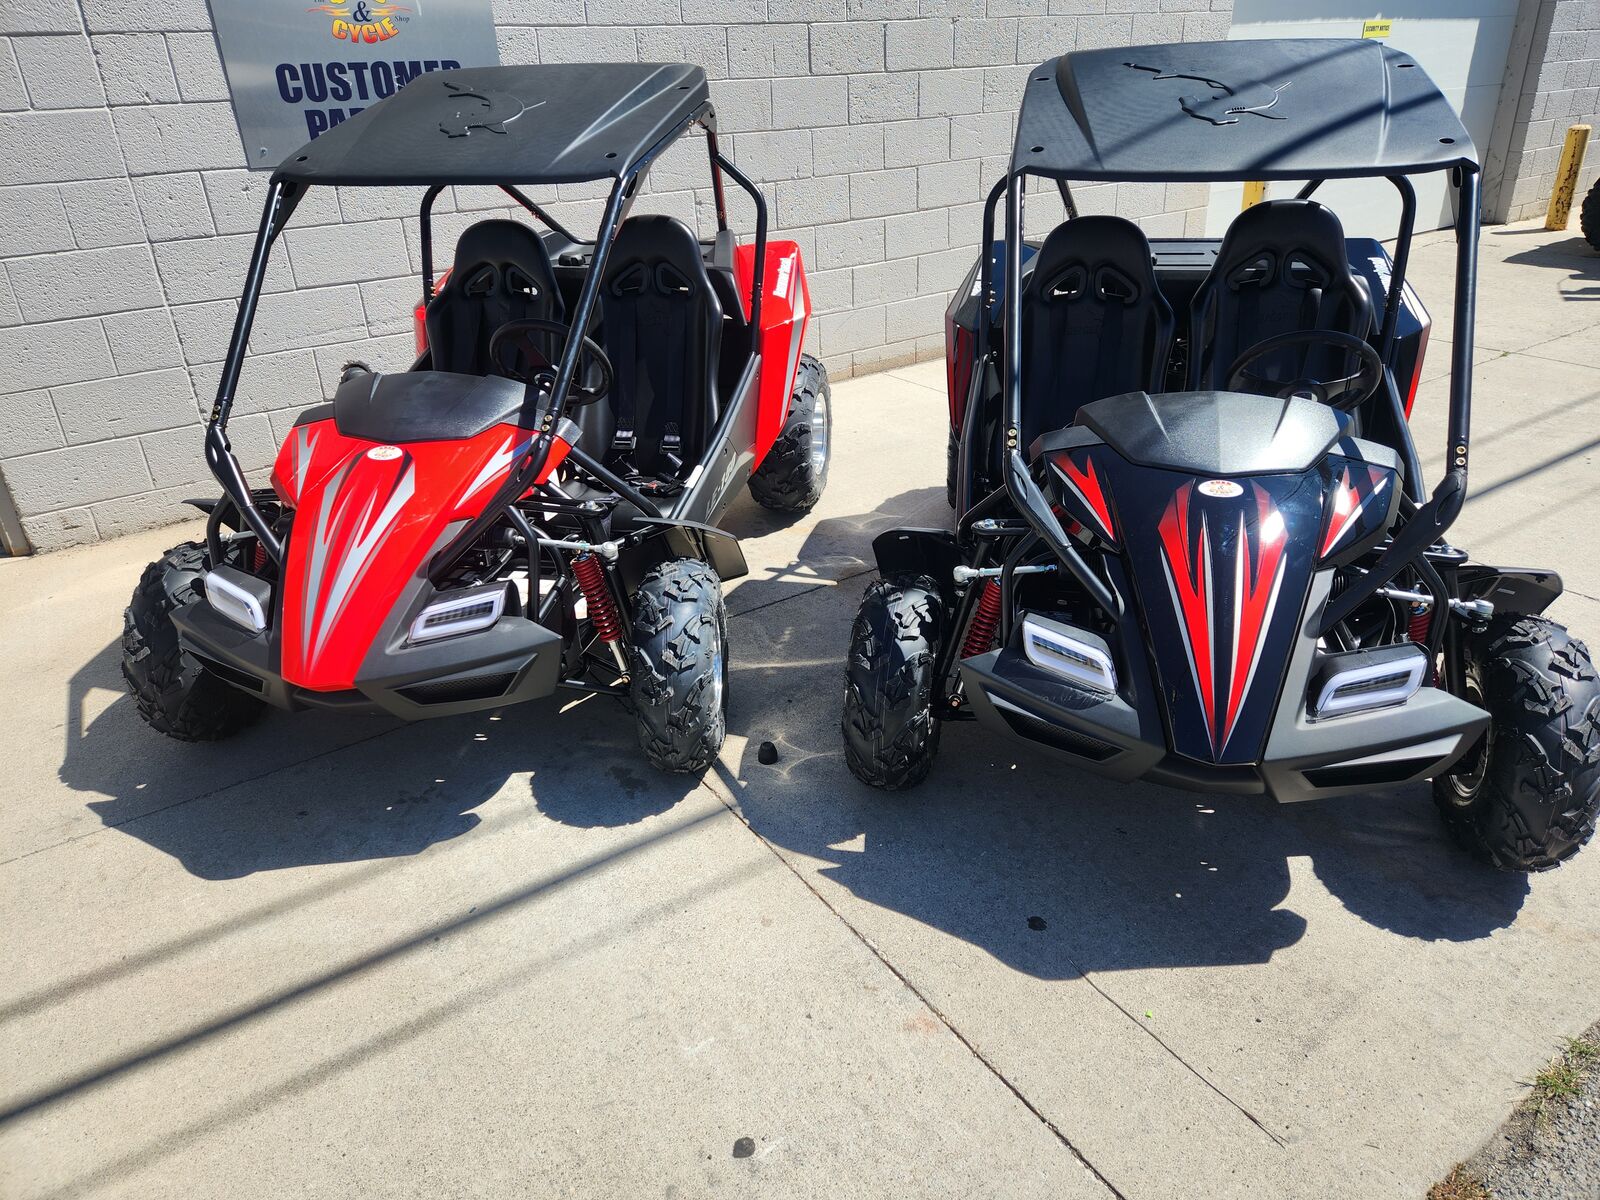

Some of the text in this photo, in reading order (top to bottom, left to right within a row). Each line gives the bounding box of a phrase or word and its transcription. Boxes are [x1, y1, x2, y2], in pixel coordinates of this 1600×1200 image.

[353, 1, 372, 22] &
[394, 15, 410, 23] Shop
[332, 16, 399, 44] CYCLE
[275, 60, 461, 103] CUSTOM
